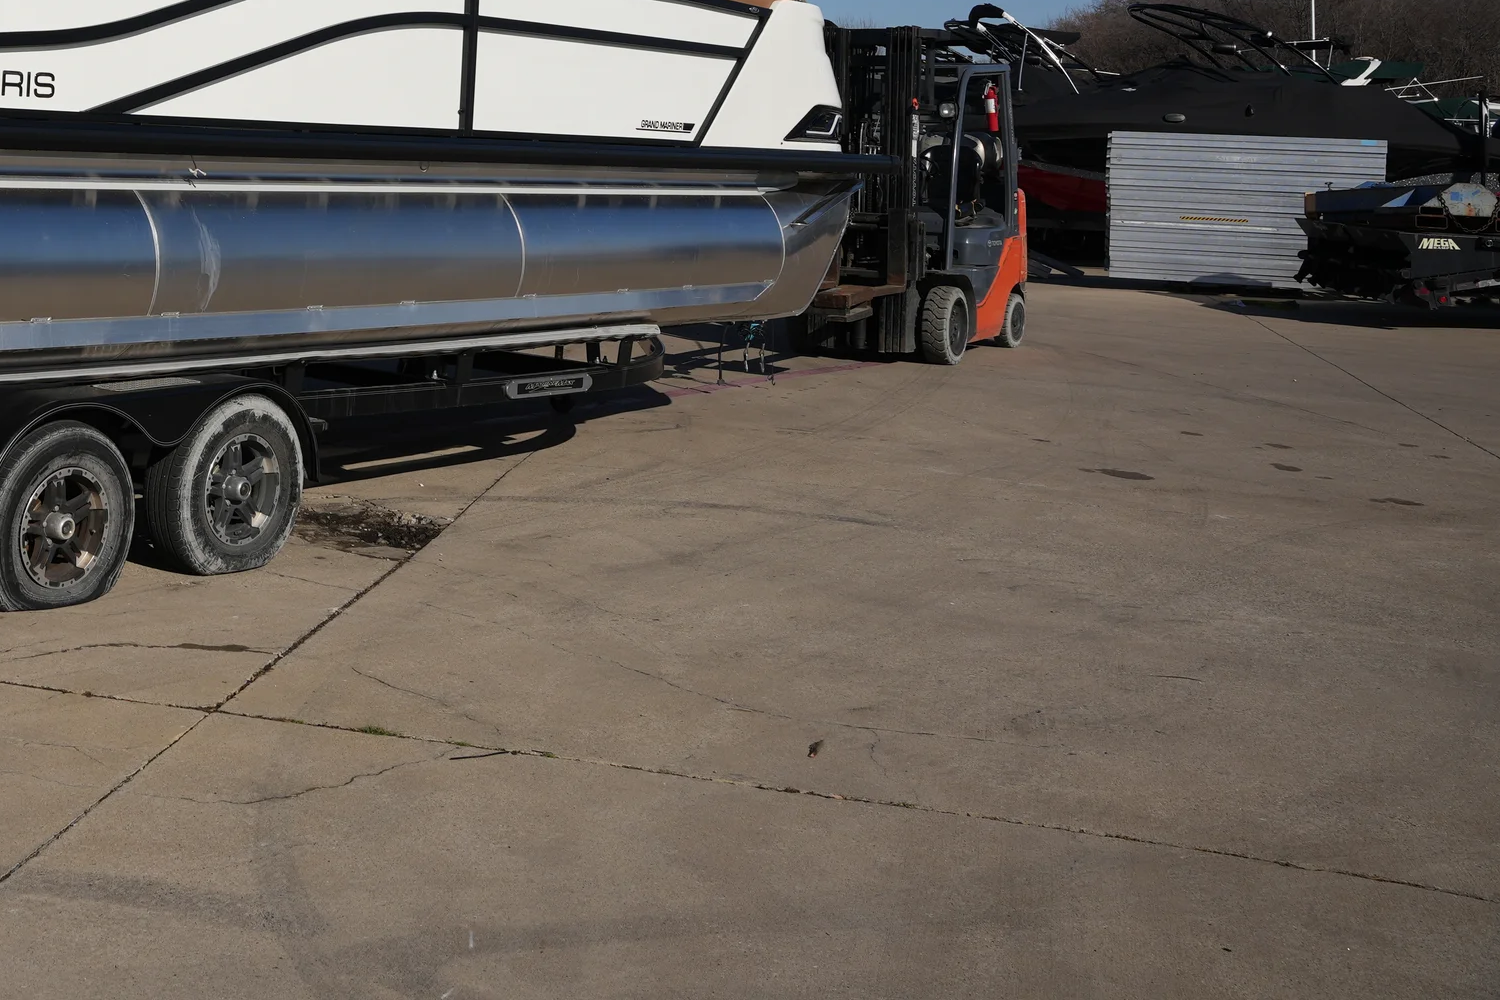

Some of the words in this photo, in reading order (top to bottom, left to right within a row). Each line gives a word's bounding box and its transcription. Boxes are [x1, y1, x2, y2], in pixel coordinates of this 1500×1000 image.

[640, 119, 659, 129] GRAND
[660, 121, 683, 131] MARINER
[1418, 238, 1462, 250] MEGA
